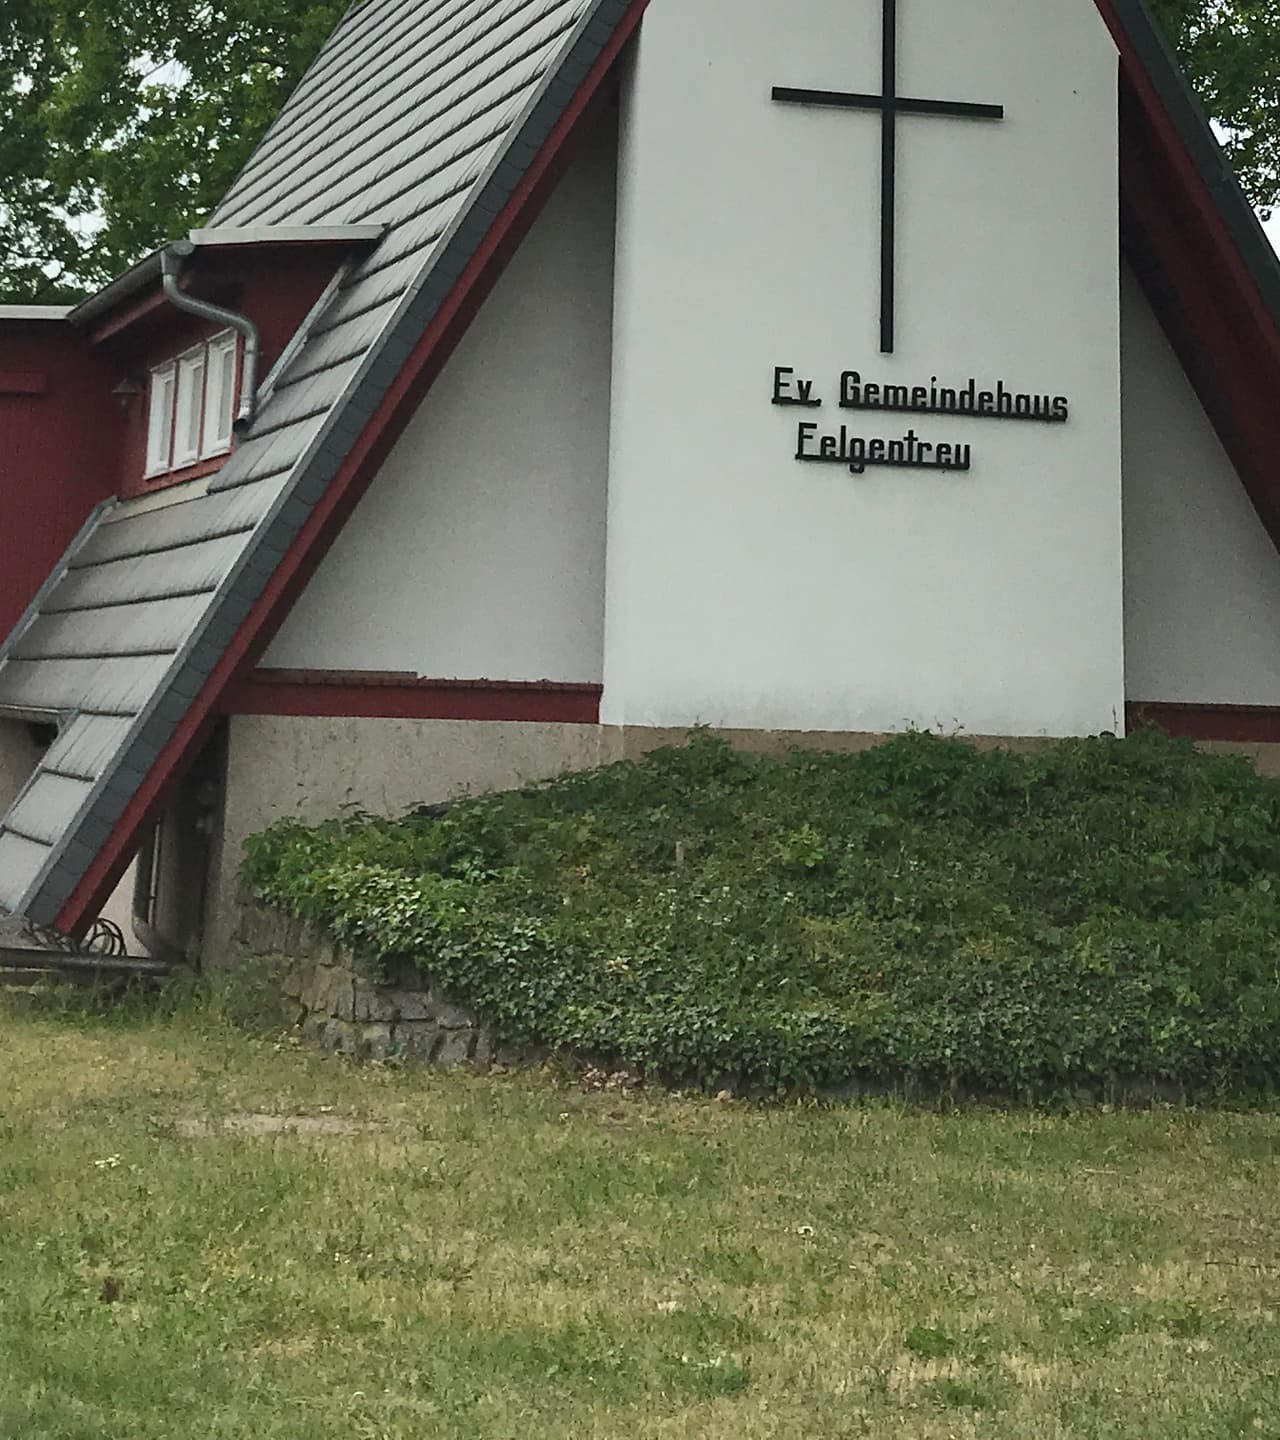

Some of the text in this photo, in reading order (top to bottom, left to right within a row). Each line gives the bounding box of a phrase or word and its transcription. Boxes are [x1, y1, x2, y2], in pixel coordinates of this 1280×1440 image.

[772, 366, 1068, 421] Ev. Gemeindehaus
[796, 422, 970, 473] Felgentreu
